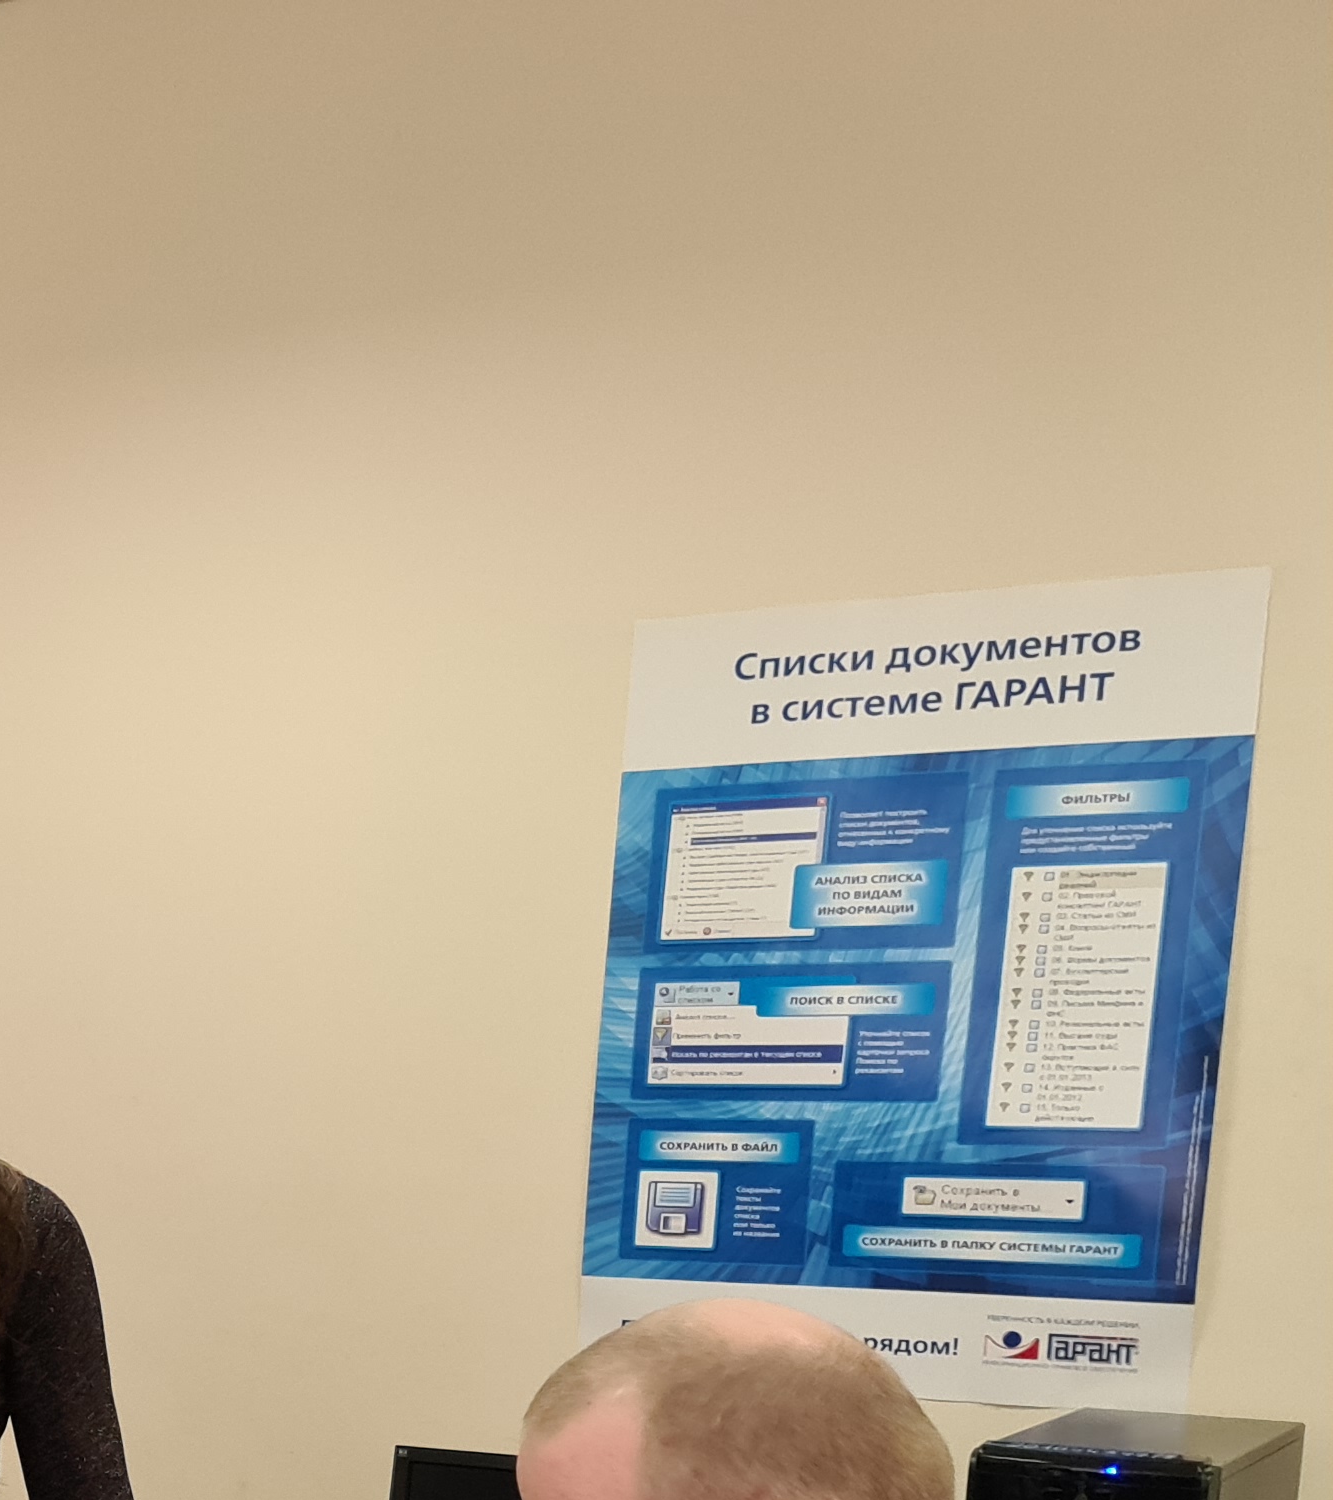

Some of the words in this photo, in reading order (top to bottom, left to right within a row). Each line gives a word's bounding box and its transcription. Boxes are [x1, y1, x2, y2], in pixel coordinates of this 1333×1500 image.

[734, 648, 875, 681] Списки
[884, 628, 1142, 674] документов
[750, 702, 770, 725] в
[782, 691, 943, 723] системе
[955, 671, 1115, 711] ГАРАНТ
[1061, 792, 1131, 805] ФИЛЬТРЫ
[815, 875, 868, 887] АНАЛИЗ
[870, 872, 924, 885] СПИСКА
[832, 890, 851, 901] ПО
[853, 888, 903, 900] ВИДАМ
[817, 903, 915, 916] ИНФОРМАЦИИ
[789, 995, 834, 1006] ПОИСК
[836, 995, 845, 1005] В
[847, 994, 899, 1005] СПИСКЕ
[659, 1141, 728, 1151] СОХРАНИТЬ
[732, 1143, 738, 1151] В
[741, 1141, 778, 1153] ФАЙЛ
[940, 1184, 1008, 1198] Сохранить
[861, 1236, 937, 1249] СОХРАНИТЬ
[940, 1239, 948, 1249] В
[951, 1239, 997, 1251] ПАПКУ
[999, 1241, 1066, 1254] СИСТЕМЫ
[1069, 1244, 1119, 1256] ГАРАНТ
[863, 1336, 959, 1356] рядом!
